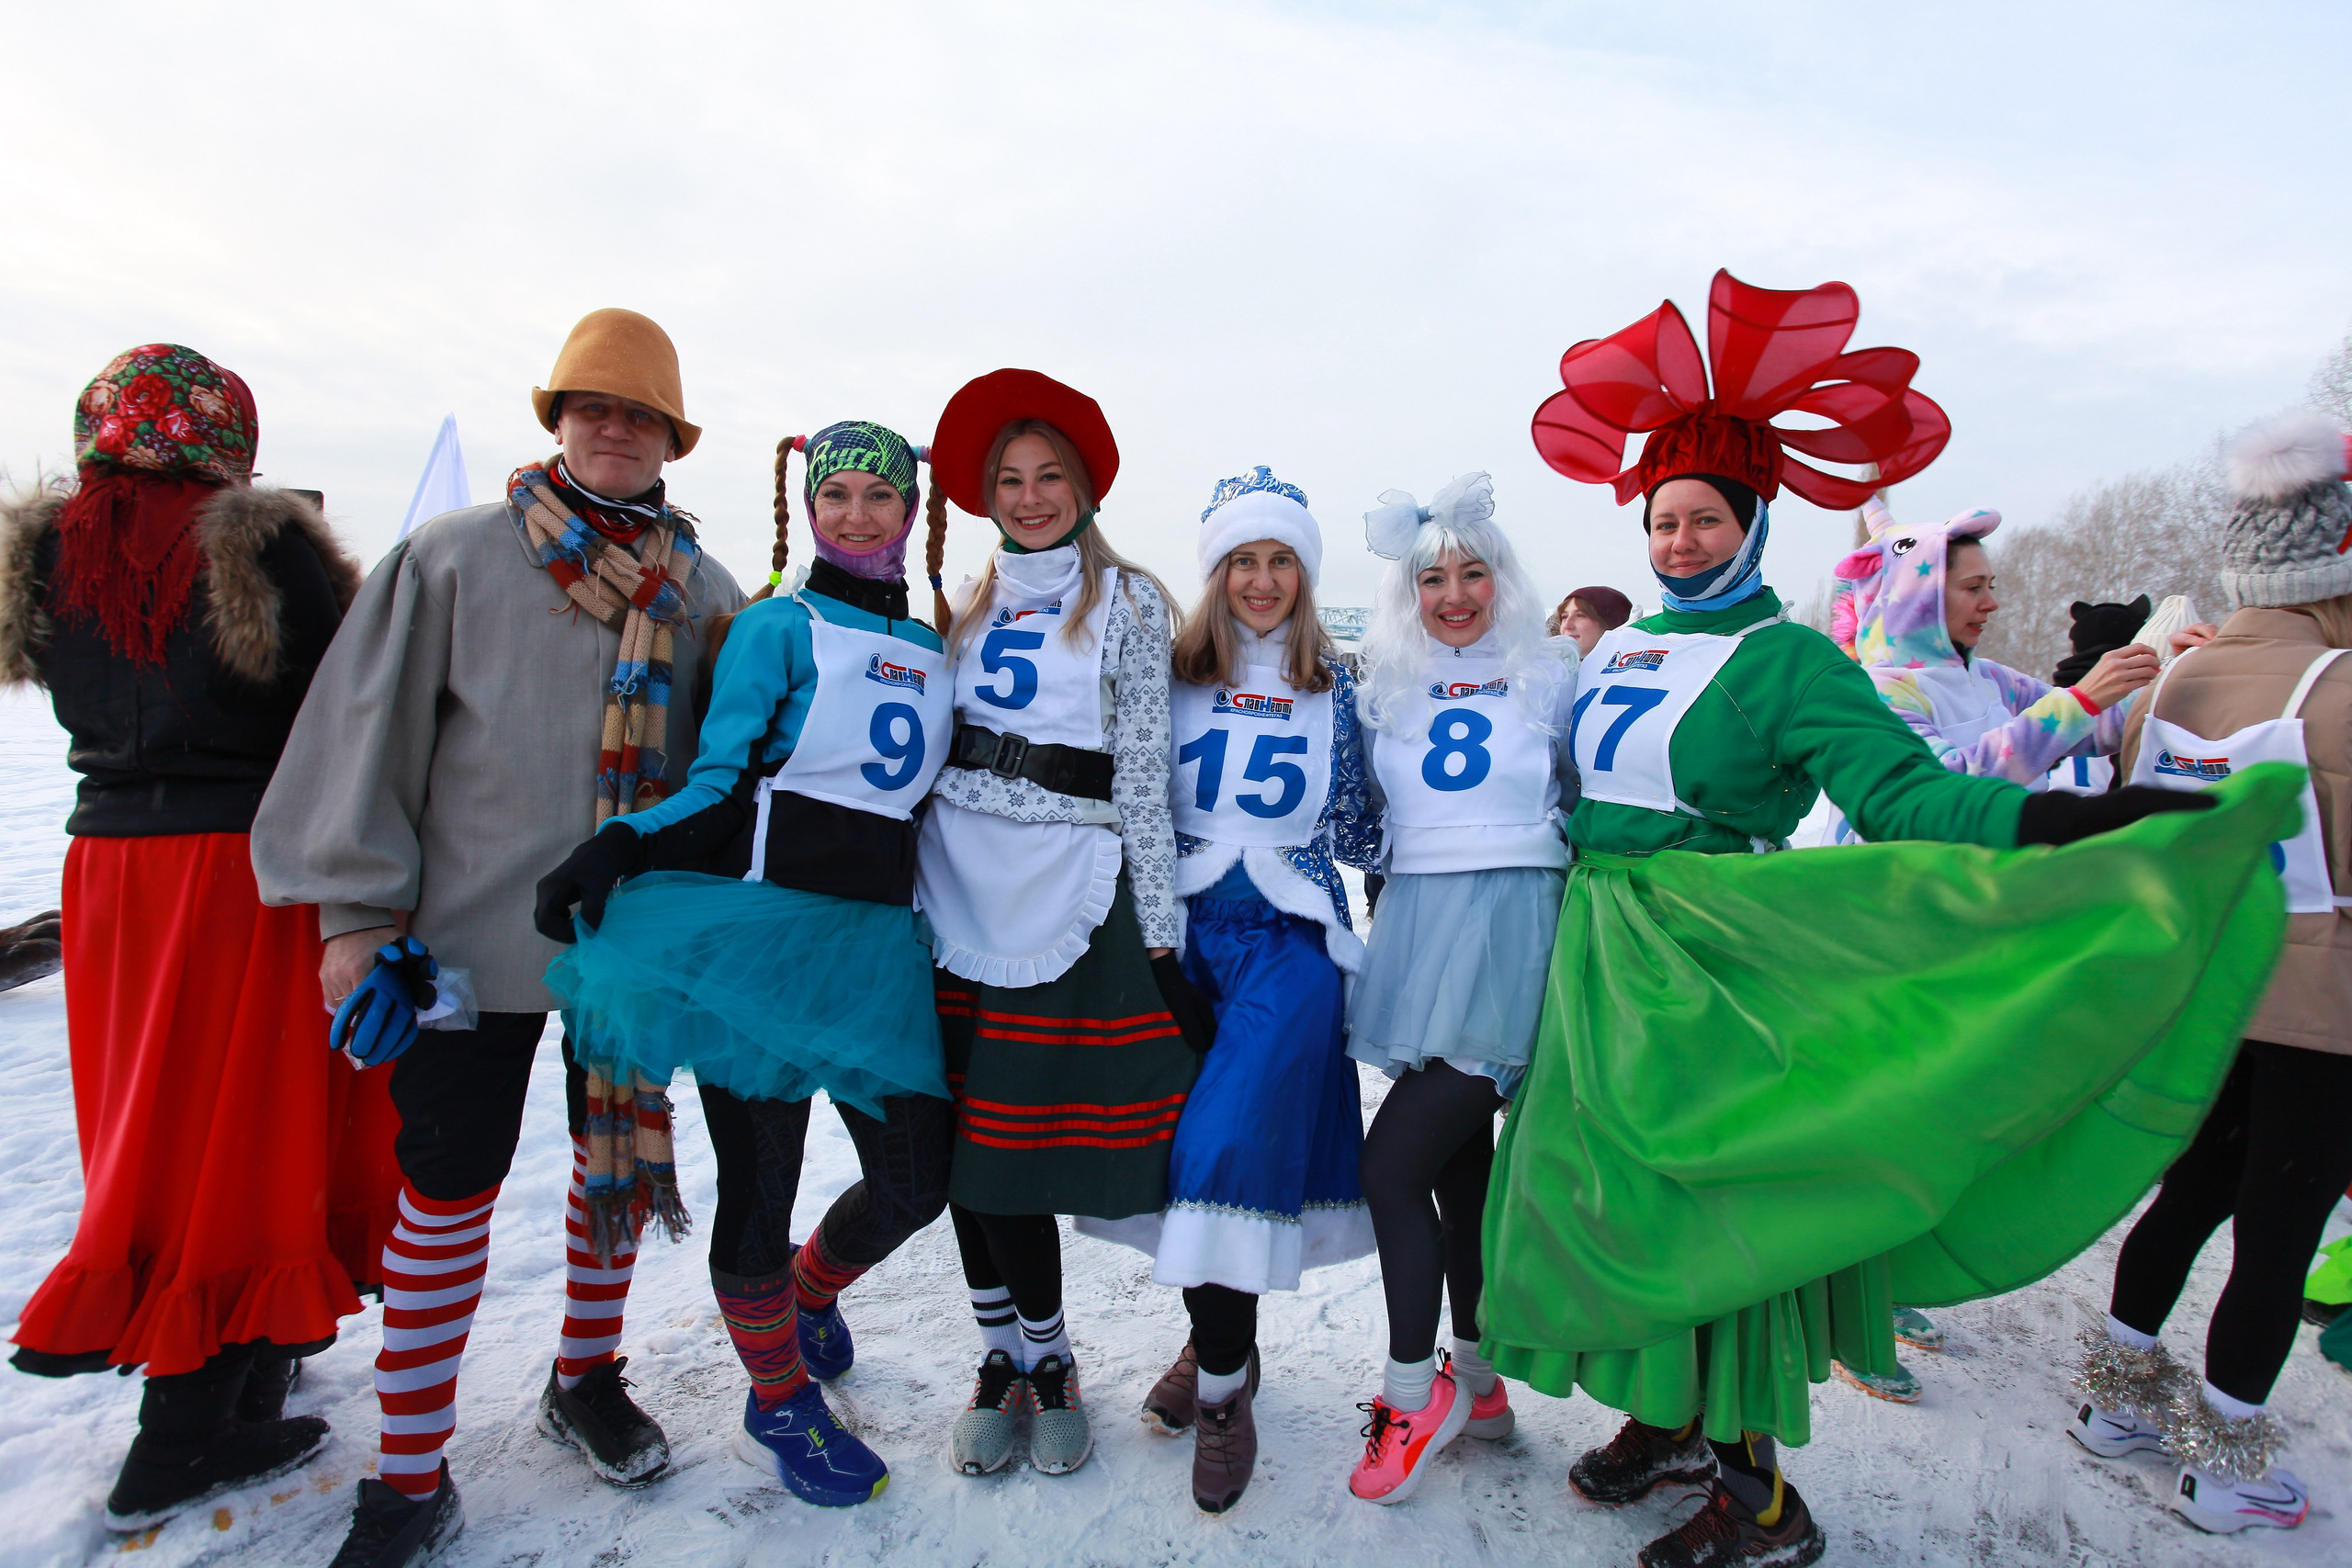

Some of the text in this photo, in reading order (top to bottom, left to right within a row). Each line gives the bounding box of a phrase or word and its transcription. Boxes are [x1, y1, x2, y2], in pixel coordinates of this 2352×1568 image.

[975, 629, 1046, 710] 5
[860, 702, 926, 791] 9
[1421, 708, 1493, 792] 8
[1569, 685, 1669, 772] 17
[1179, 728, 1308, 818] 15
